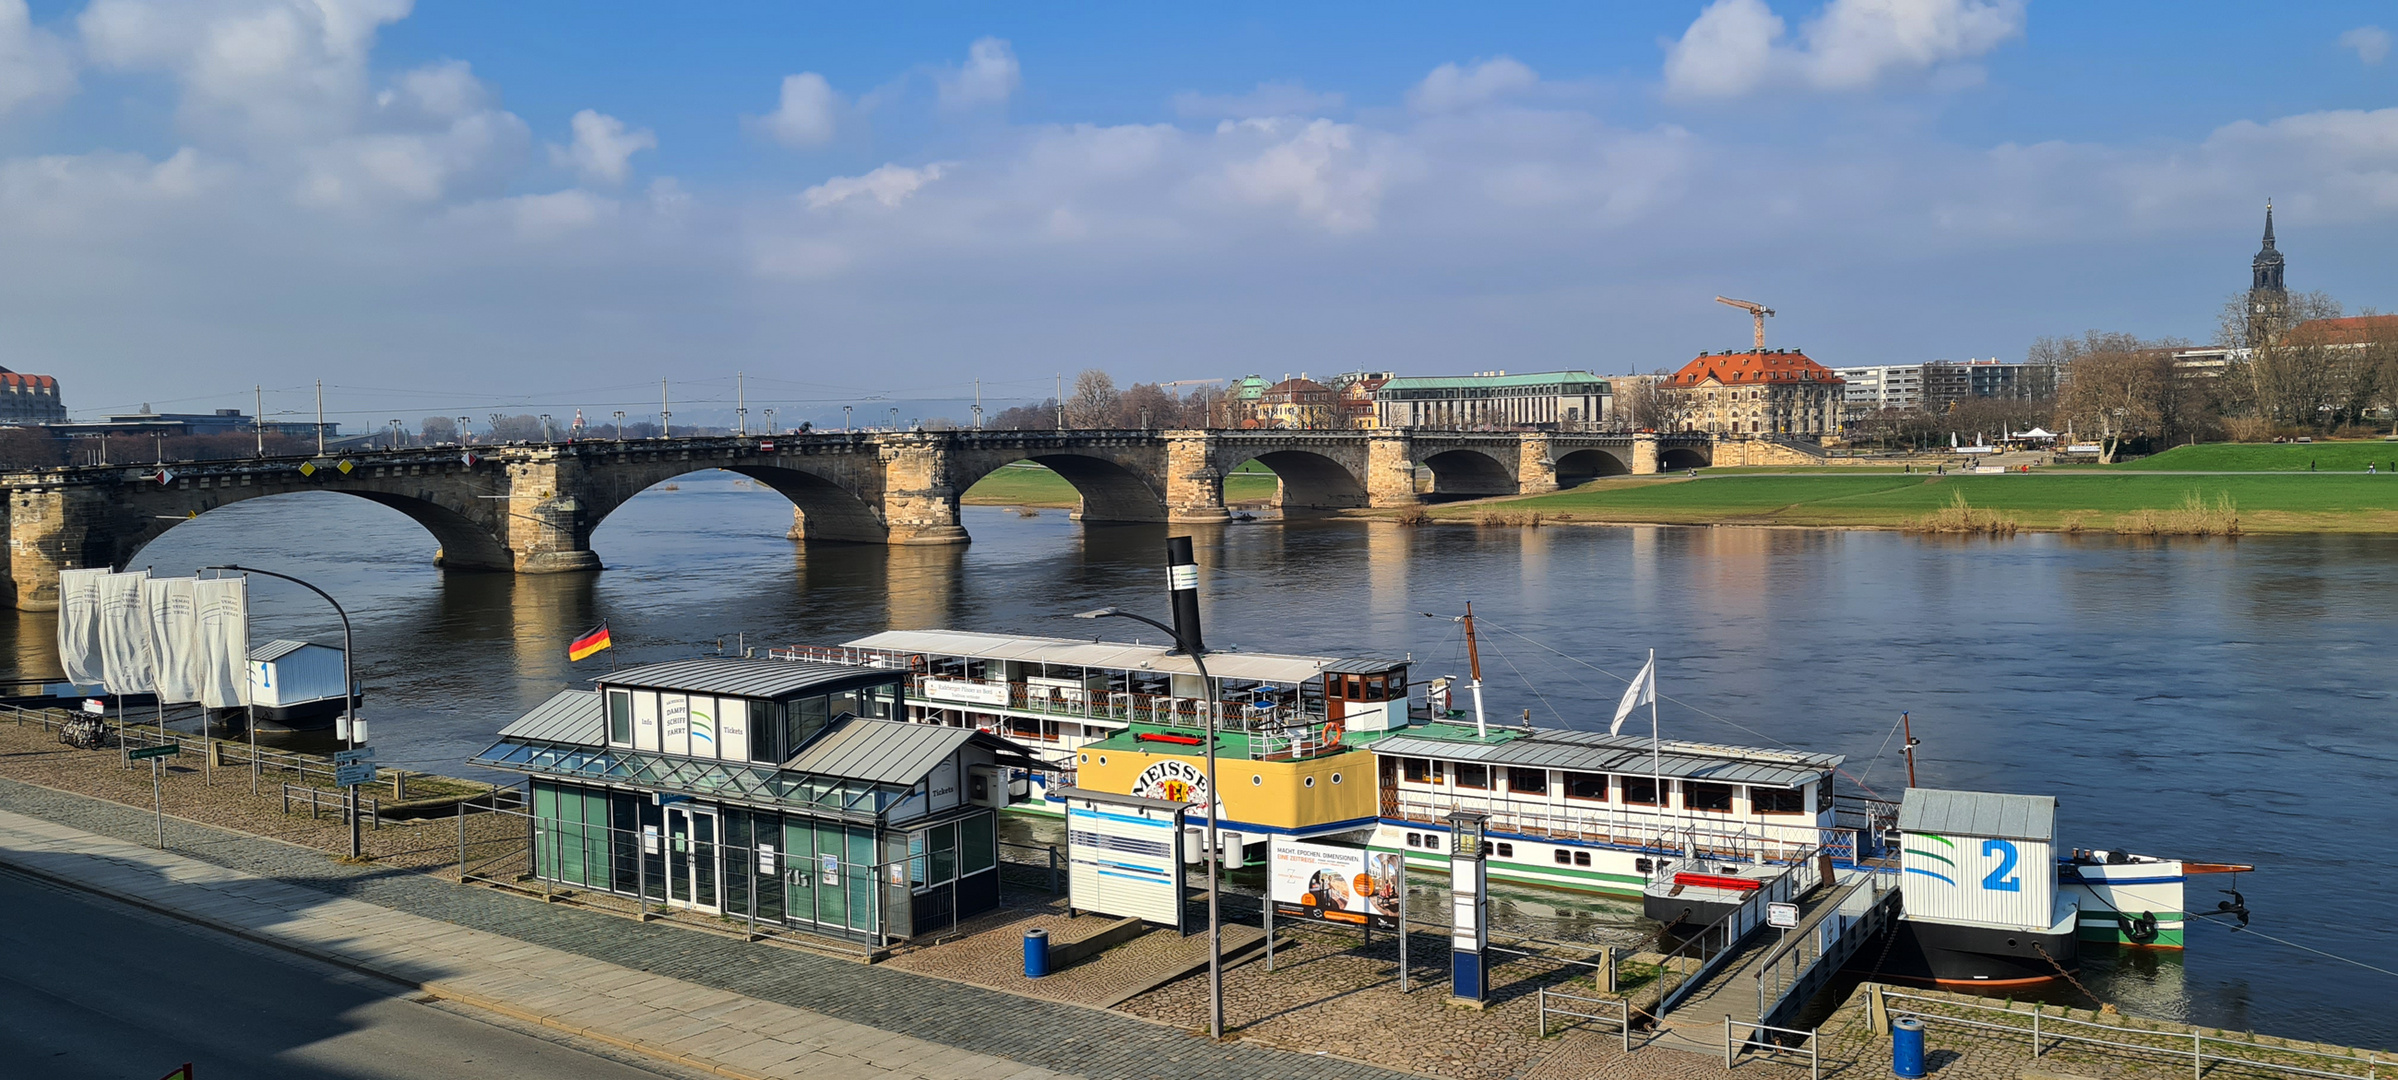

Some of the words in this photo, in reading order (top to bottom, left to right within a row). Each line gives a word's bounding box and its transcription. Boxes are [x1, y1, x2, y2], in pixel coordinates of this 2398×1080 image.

[261, 662, 270, 688] 1
[666, 706, 686, 716] DAMPF
[641, 718, 653, 726] Info
[666, 717, 686, 727] SCHIFF
[667, 727, 686, 737] FAHRT
[723, 726, 744, 735] Tickets
[1132, 761, 1221, 807] MEISSE
[932, 786, 954, 797] Tickets
[1277, 847, 1296, 855] MACHT.
[1297, 849, 1321, 858] EPOCHEN.
[1322, 852, 1360, 863] DIMENSIONEN.
[1277, 853, 1289, 861] EINE
[1982, 839, 2020, 892] 2
